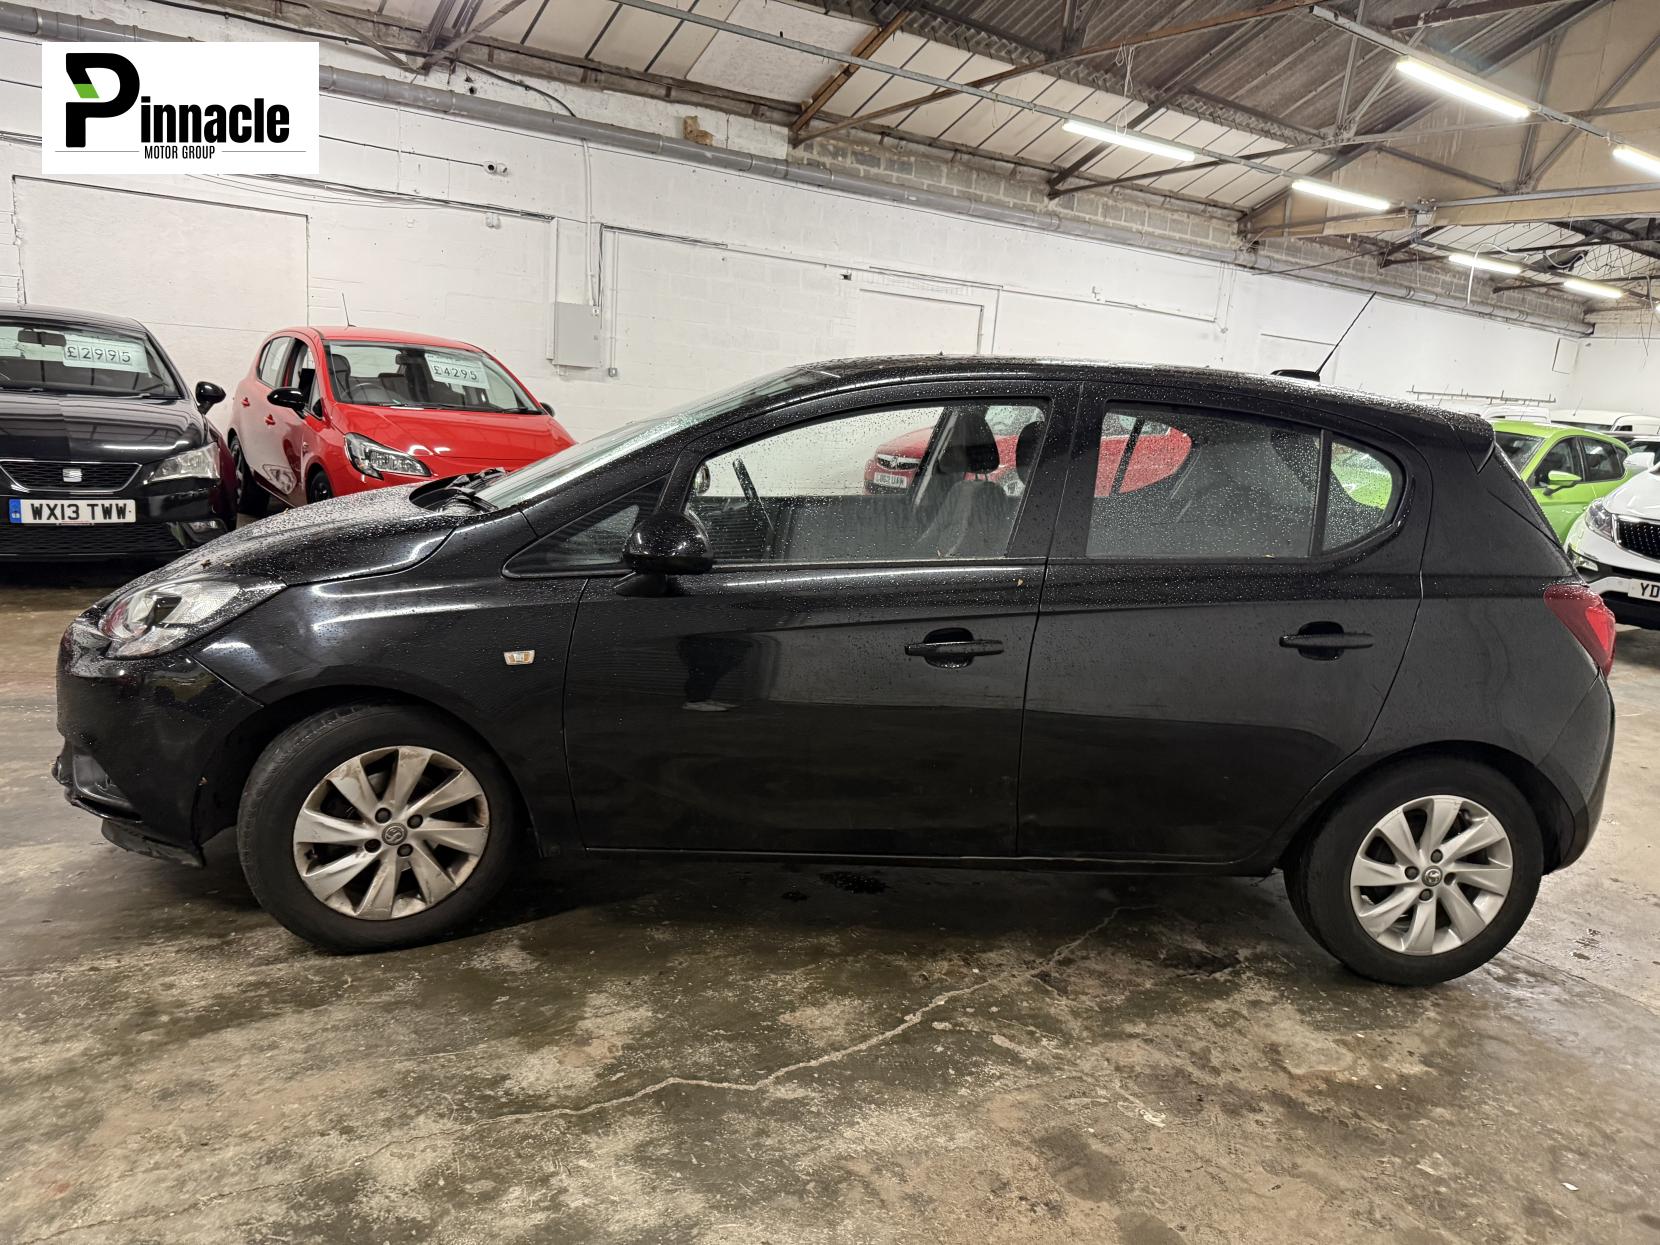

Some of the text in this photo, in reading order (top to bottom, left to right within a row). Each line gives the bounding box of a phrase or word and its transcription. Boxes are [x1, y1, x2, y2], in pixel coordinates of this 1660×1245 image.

[67, 346, 131, 363] £2995
[433, 365, 477, 380] £4295
[31, 503, 127, 520] WX13 TWW
